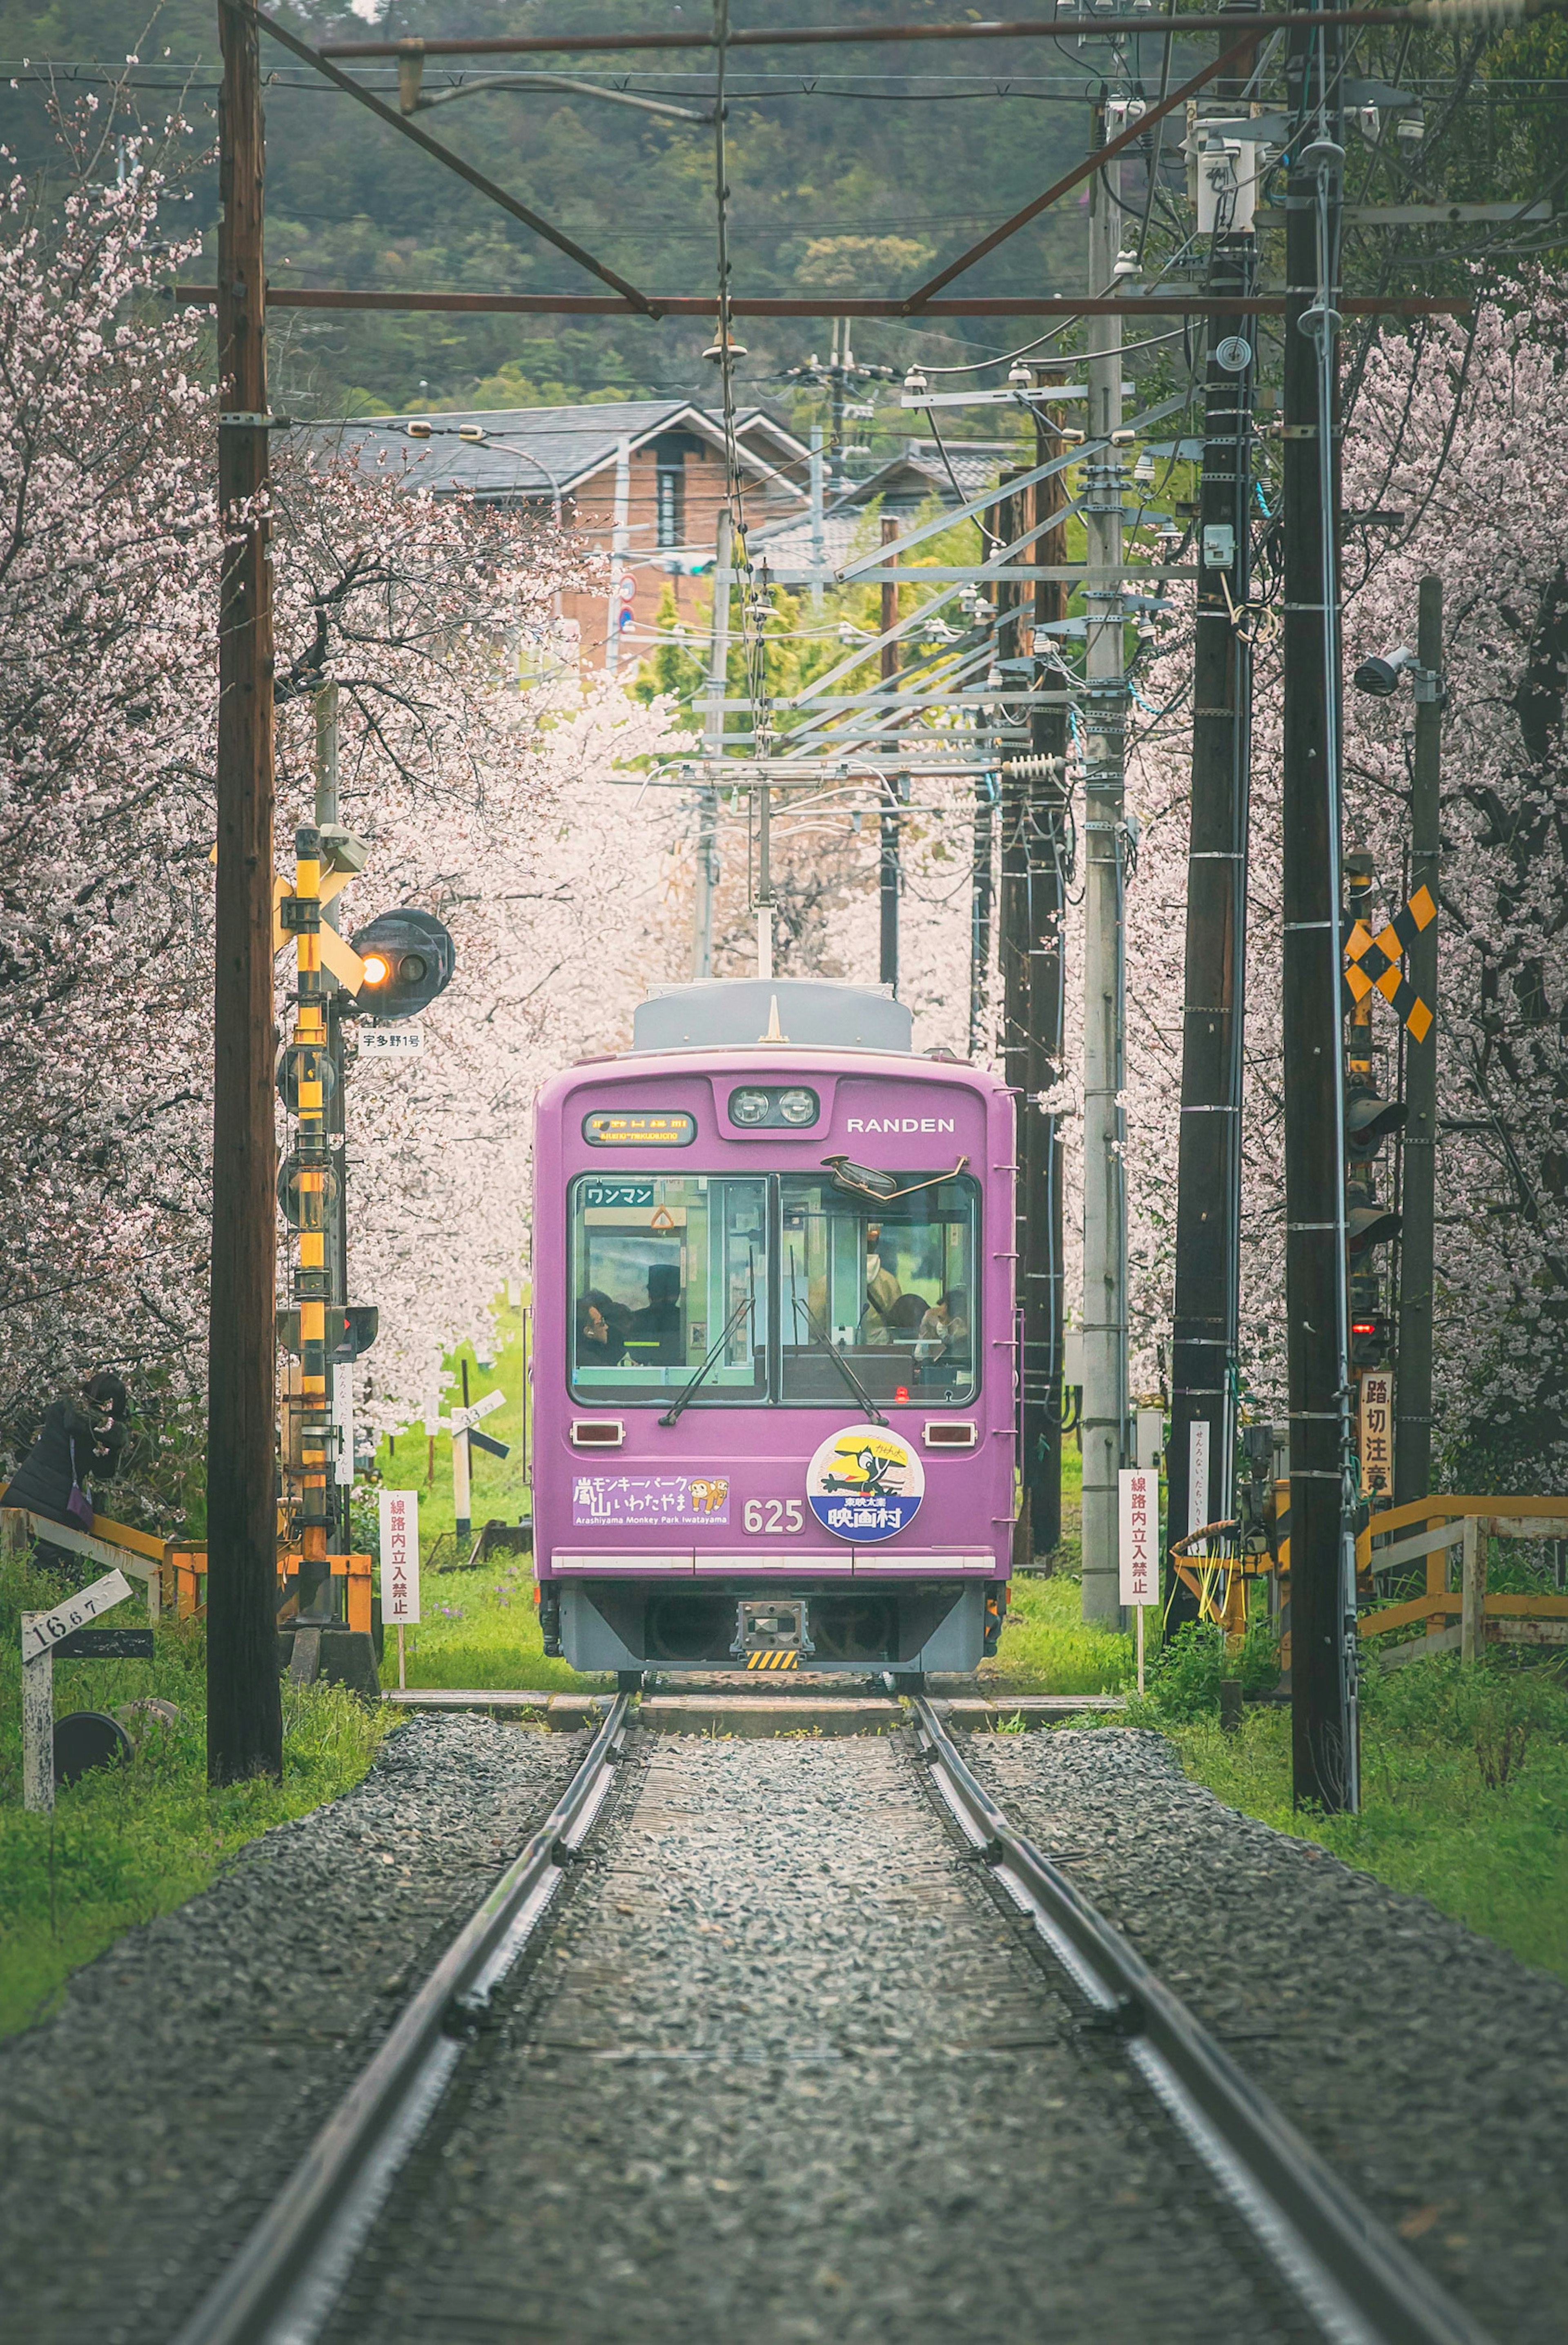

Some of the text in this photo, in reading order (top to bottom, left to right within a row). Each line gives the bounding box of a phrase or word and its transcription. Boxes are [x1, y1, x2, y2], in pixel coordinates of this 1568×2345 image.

[363, 1035, 419, 1047] 宇多野1号
[848, 1119, 954, 1132] RANDEN
[588, 1189, 651, 1204] ワンマン
[1366, 1379, 1388, 1490] 踏切注意
[593, 1476, 687, 1492] モンキーパーク
[573, 1477, 610, 1516] 嵐山
[614, 1494, 686, 1511] いわたやま
[844, 1497, 886, 1507] 東映太秦
[576, 1517, 623, 1525] Arashiyama
[626, 1517, 658, 1525] Monkey
[682, 1516, 727, 1524] Iwatayama
[744, 1499, 804, 1533] 625
[828, 1508, 902, 1528] 映画村
[1131, 1477, 1148, 1594] 線路内立入禁止
[390, 1500, 408, 1614] 線路内立入禁止
